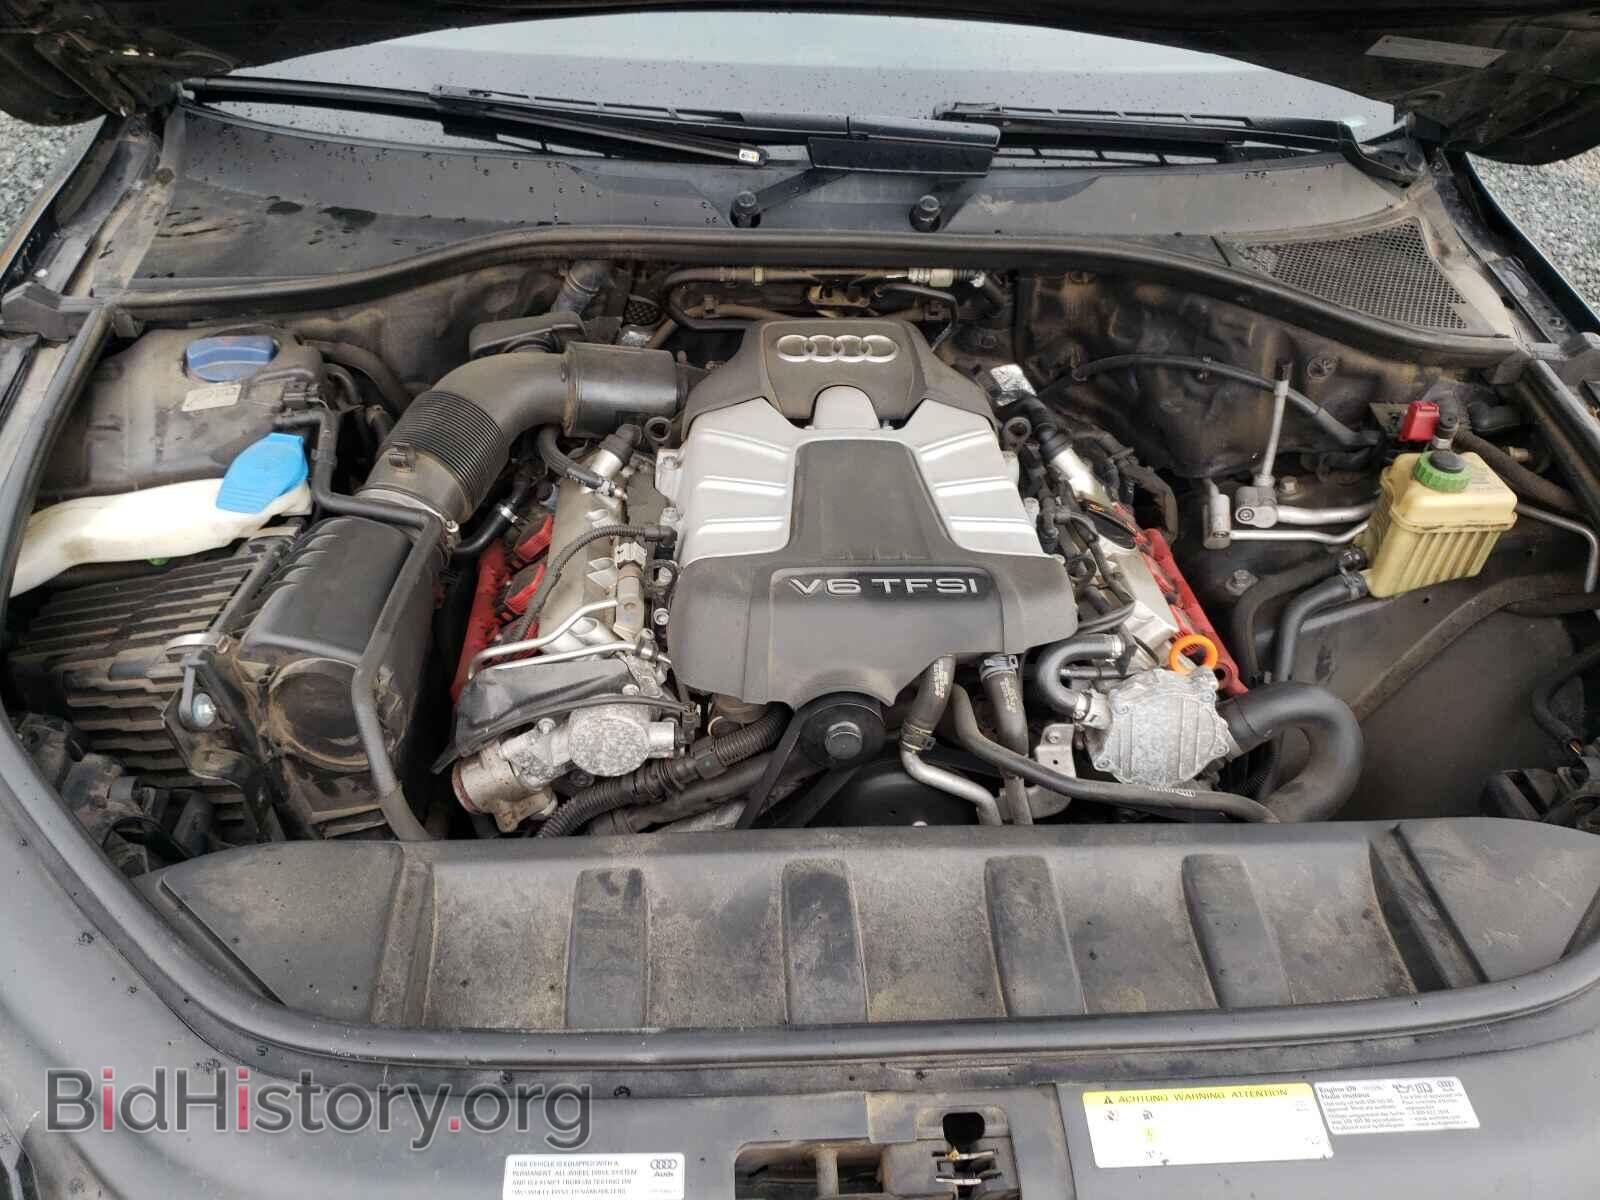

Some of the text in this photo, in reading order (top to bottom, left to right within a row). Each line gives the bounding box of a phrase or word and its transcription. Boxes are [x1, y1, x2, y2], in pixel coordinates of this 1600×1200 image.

[789, 577, 978, 595] V6 TFSI
[1118, 1089, 1289, 1104] ACHTUNG WARNING ATTENTION
